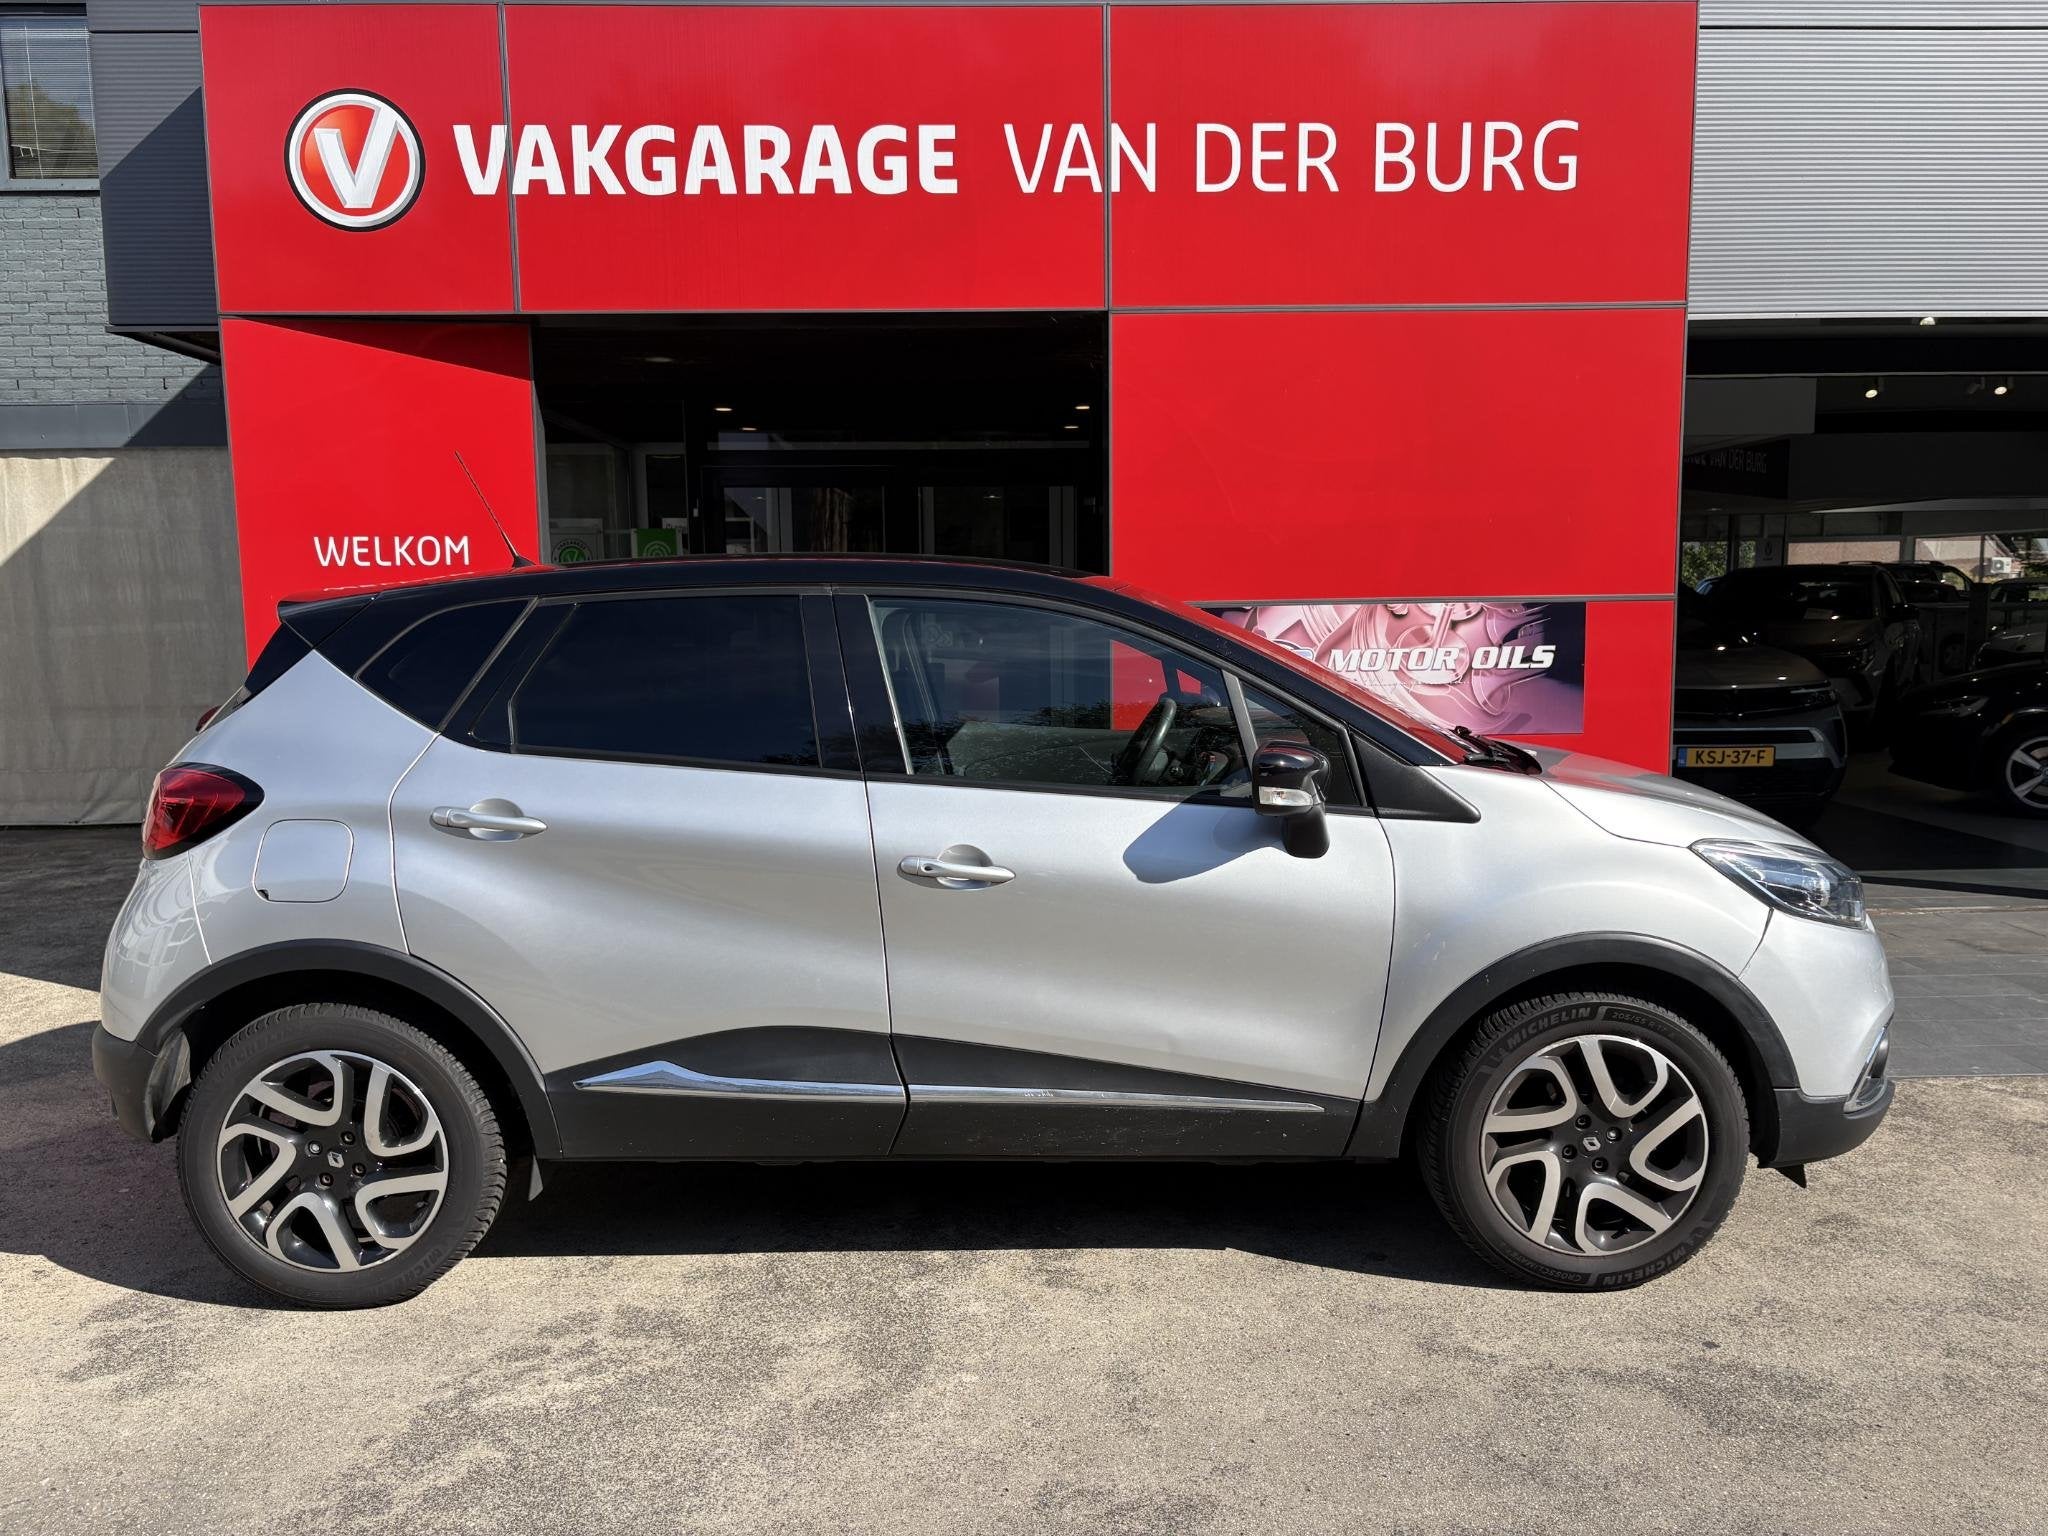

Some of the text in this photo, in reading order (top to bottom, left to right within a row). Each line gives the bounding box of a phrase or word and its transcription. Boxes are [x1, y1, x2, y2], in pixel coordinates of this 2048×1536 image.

[452, 119, 1580, 197] VAKGARAGE VAN DER BURG
[313, 535, 470, 567] WELKOM
[1327, 644, 1556, 672] MOTOR OILS
[1695, 749, 1766, 765] KSJ-37-F
[1505, 1006, 1592, 1050] MICHELIN
[1602, 1245, 1688, 1285] MICHELIN
